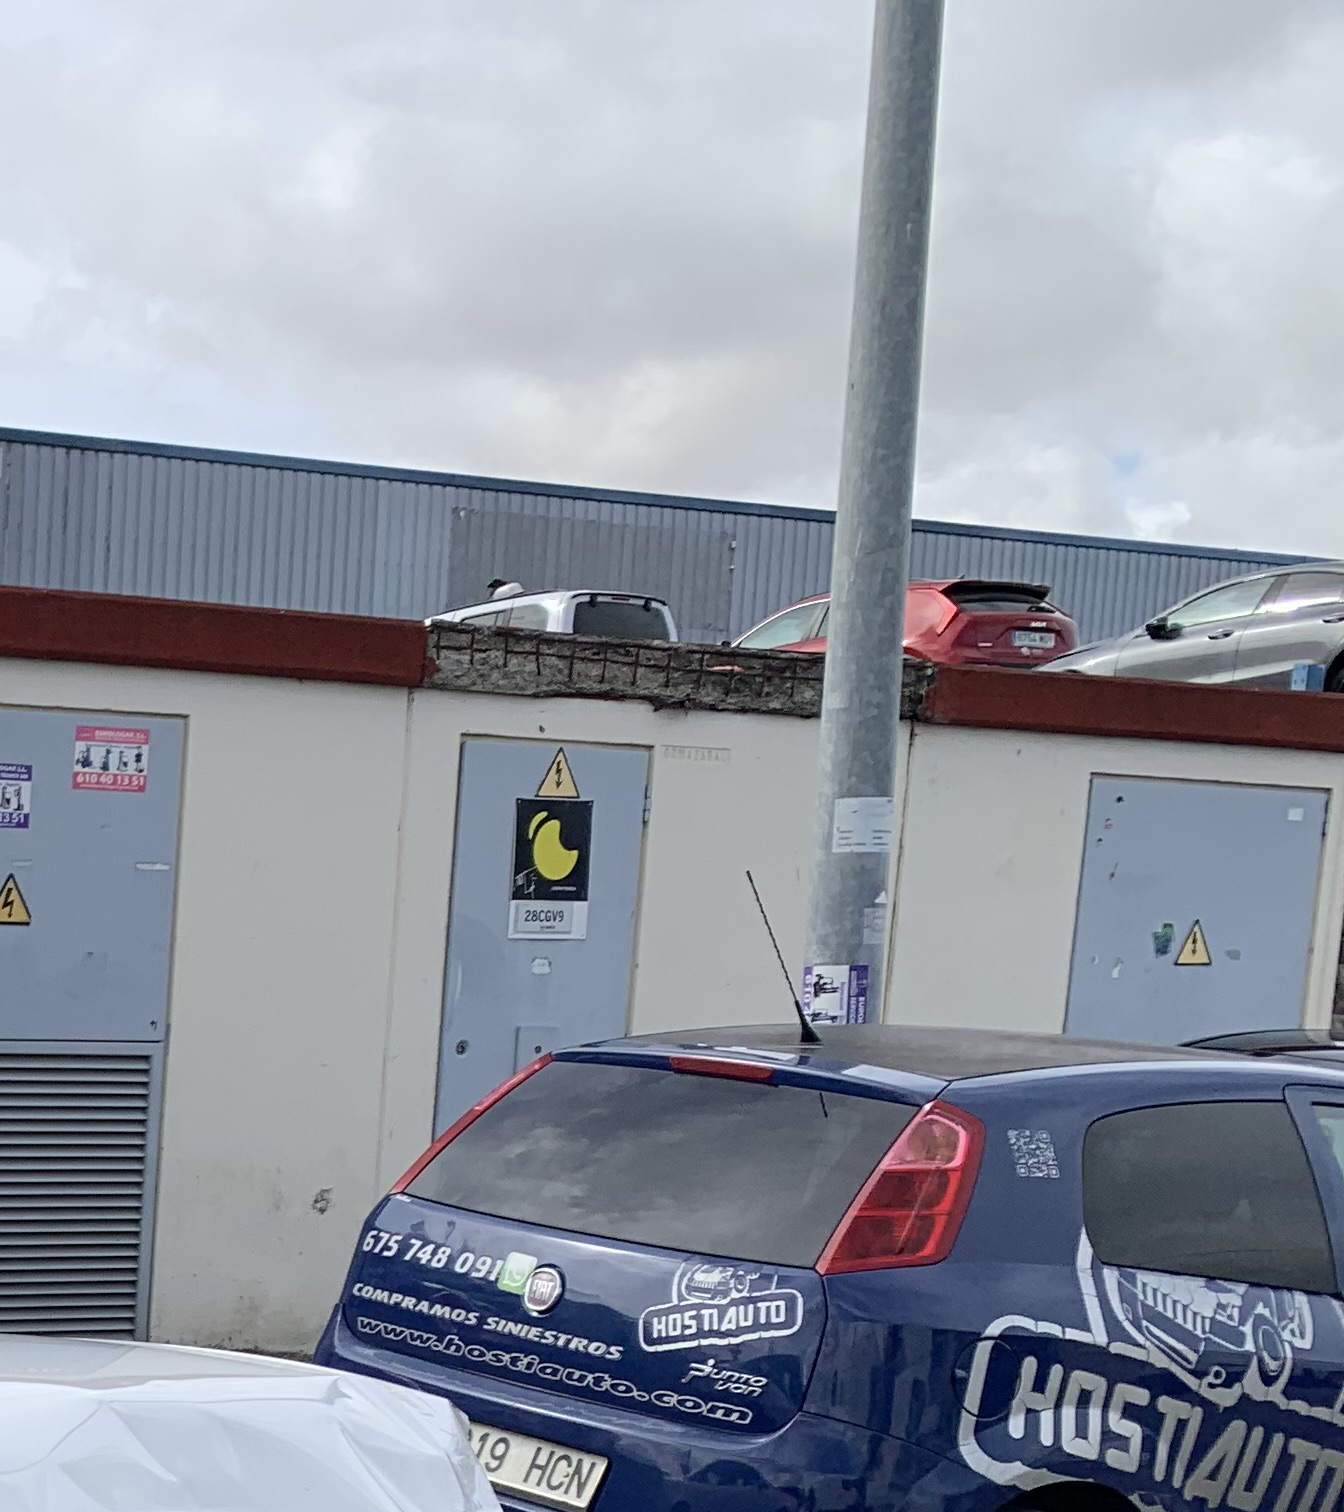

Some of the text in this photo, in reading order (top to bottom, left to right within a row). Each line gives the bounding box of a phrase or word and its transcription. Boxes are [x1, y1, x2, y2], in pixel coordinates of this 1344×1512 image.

[76, 772, 145, 786] 610 40 13 51
[11, 813, 25, 823] 51
[524, 909, 565, 923] 28CGV9
[363, 1230, 505, 1282] 675 748 091
[531, 1279, 554, 1301] FIAT
[352, 1282, 625, 1361] COMPRAMOS SINIESTROS
[651, 1300, 786, 1339] HOSTIAUTO
[357, 1316, 754, 1424] www.hostiauto.com
[522, 1446, 597, 1499] HCN
